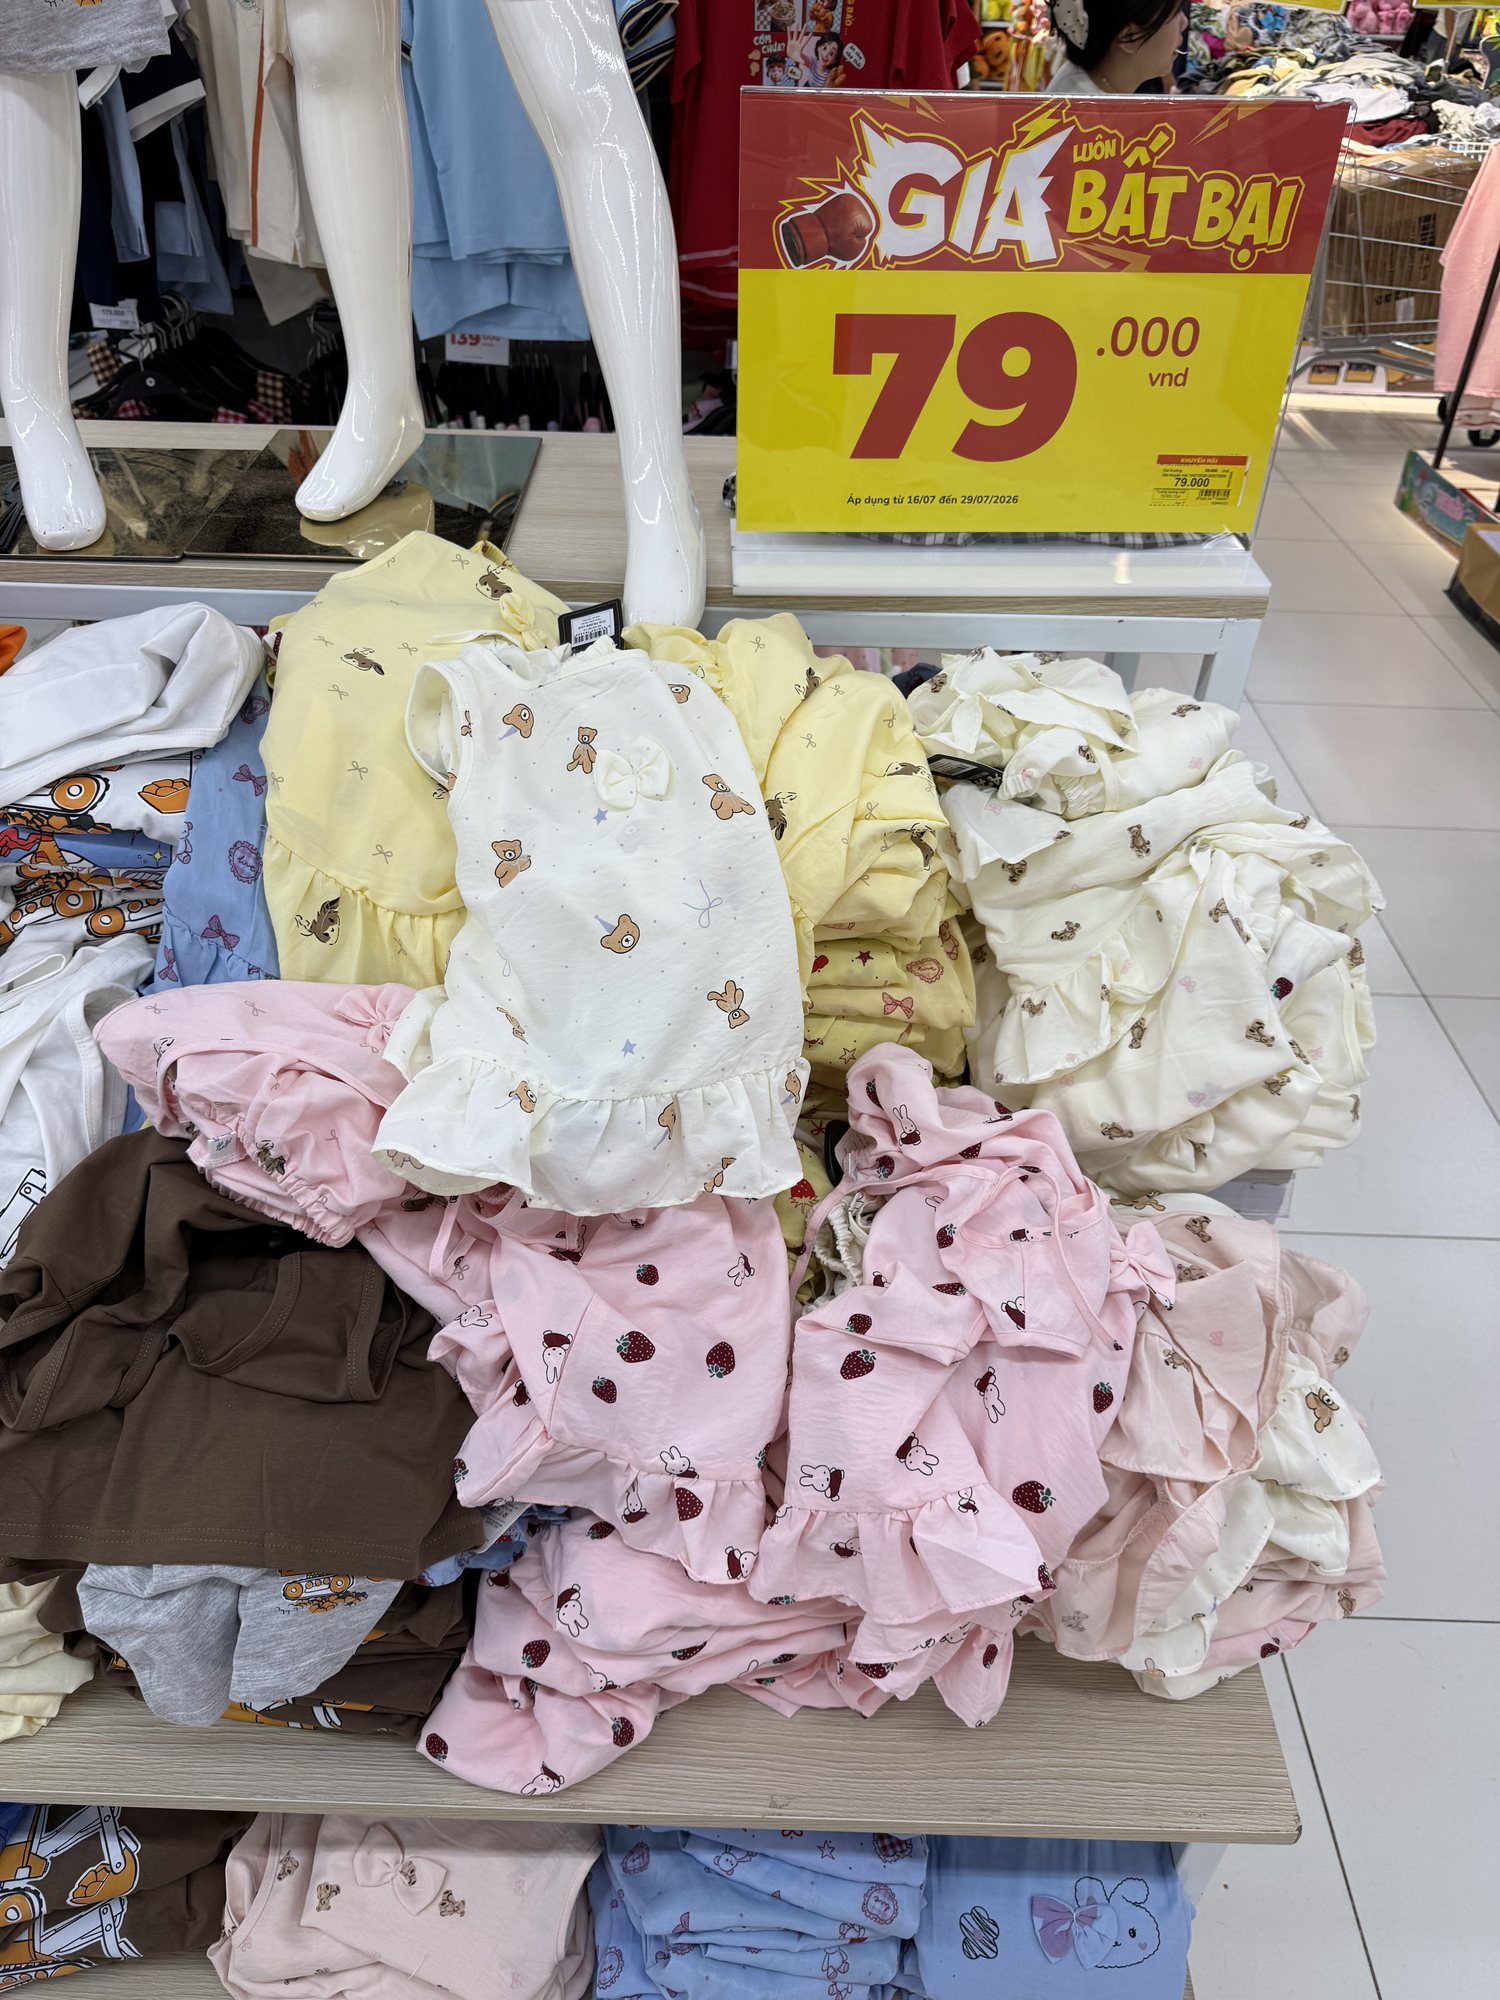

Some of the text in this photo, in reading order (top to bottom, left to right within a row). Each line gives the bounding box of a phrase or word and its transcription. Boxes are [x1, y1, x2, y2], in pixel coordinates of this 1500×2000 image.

[1072, 134, 1116, 163] LUÔN
[858, 118, 1076, 264] GIÁ
[1066, 130, 1298, 263] BẤT BẠI
[832, 311, 1078, 463] 79
[1148, 367, 1190, 388] vnd
[1174, 477, 1210, 487] 79.000
[847, 493, 1019, 507] Áp dụng từ 16/07 đến 29/07/2026
